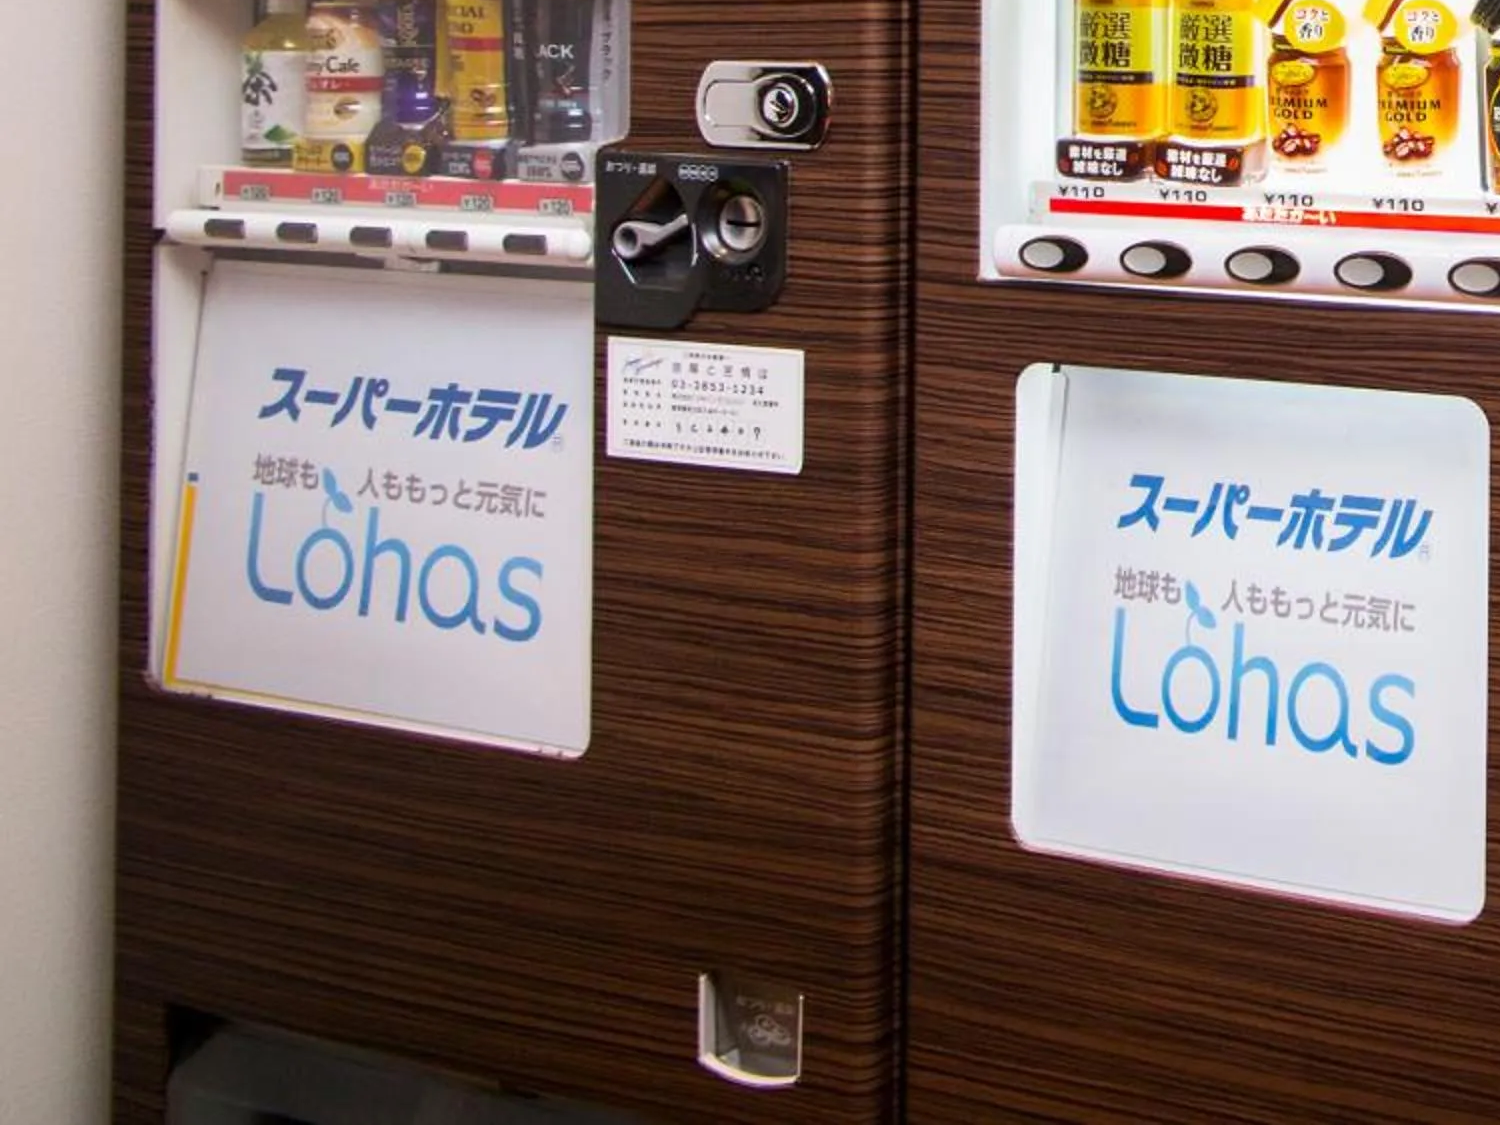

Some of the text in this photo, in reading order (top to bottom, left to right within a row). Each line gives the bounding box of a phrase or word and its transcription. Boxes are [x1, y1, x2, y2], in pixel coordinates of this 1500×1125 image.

[537, 43, 574, 60] ACK
[1179, 43, 1233, 73] 微糖
[1058, 185, 1105, 199] ¥110
[1159, 189, 1207, 203] ¥110
[1264, 193, 1313, 207] ¥110
[1372, 197, 1425, 212] ¥110
[258, 367, 568, 450] スーパーホテル
[252, 453, 548, 519] 地球も 人ももっと元気に
[1116, 472, 1434, 560] スーパーホテル
[246, 489, 545, 643] Lohas
[1113, 566, 1418, 633] 地球も 人ももっと元気に
[1110, 607, 1417, 766] Lohas
